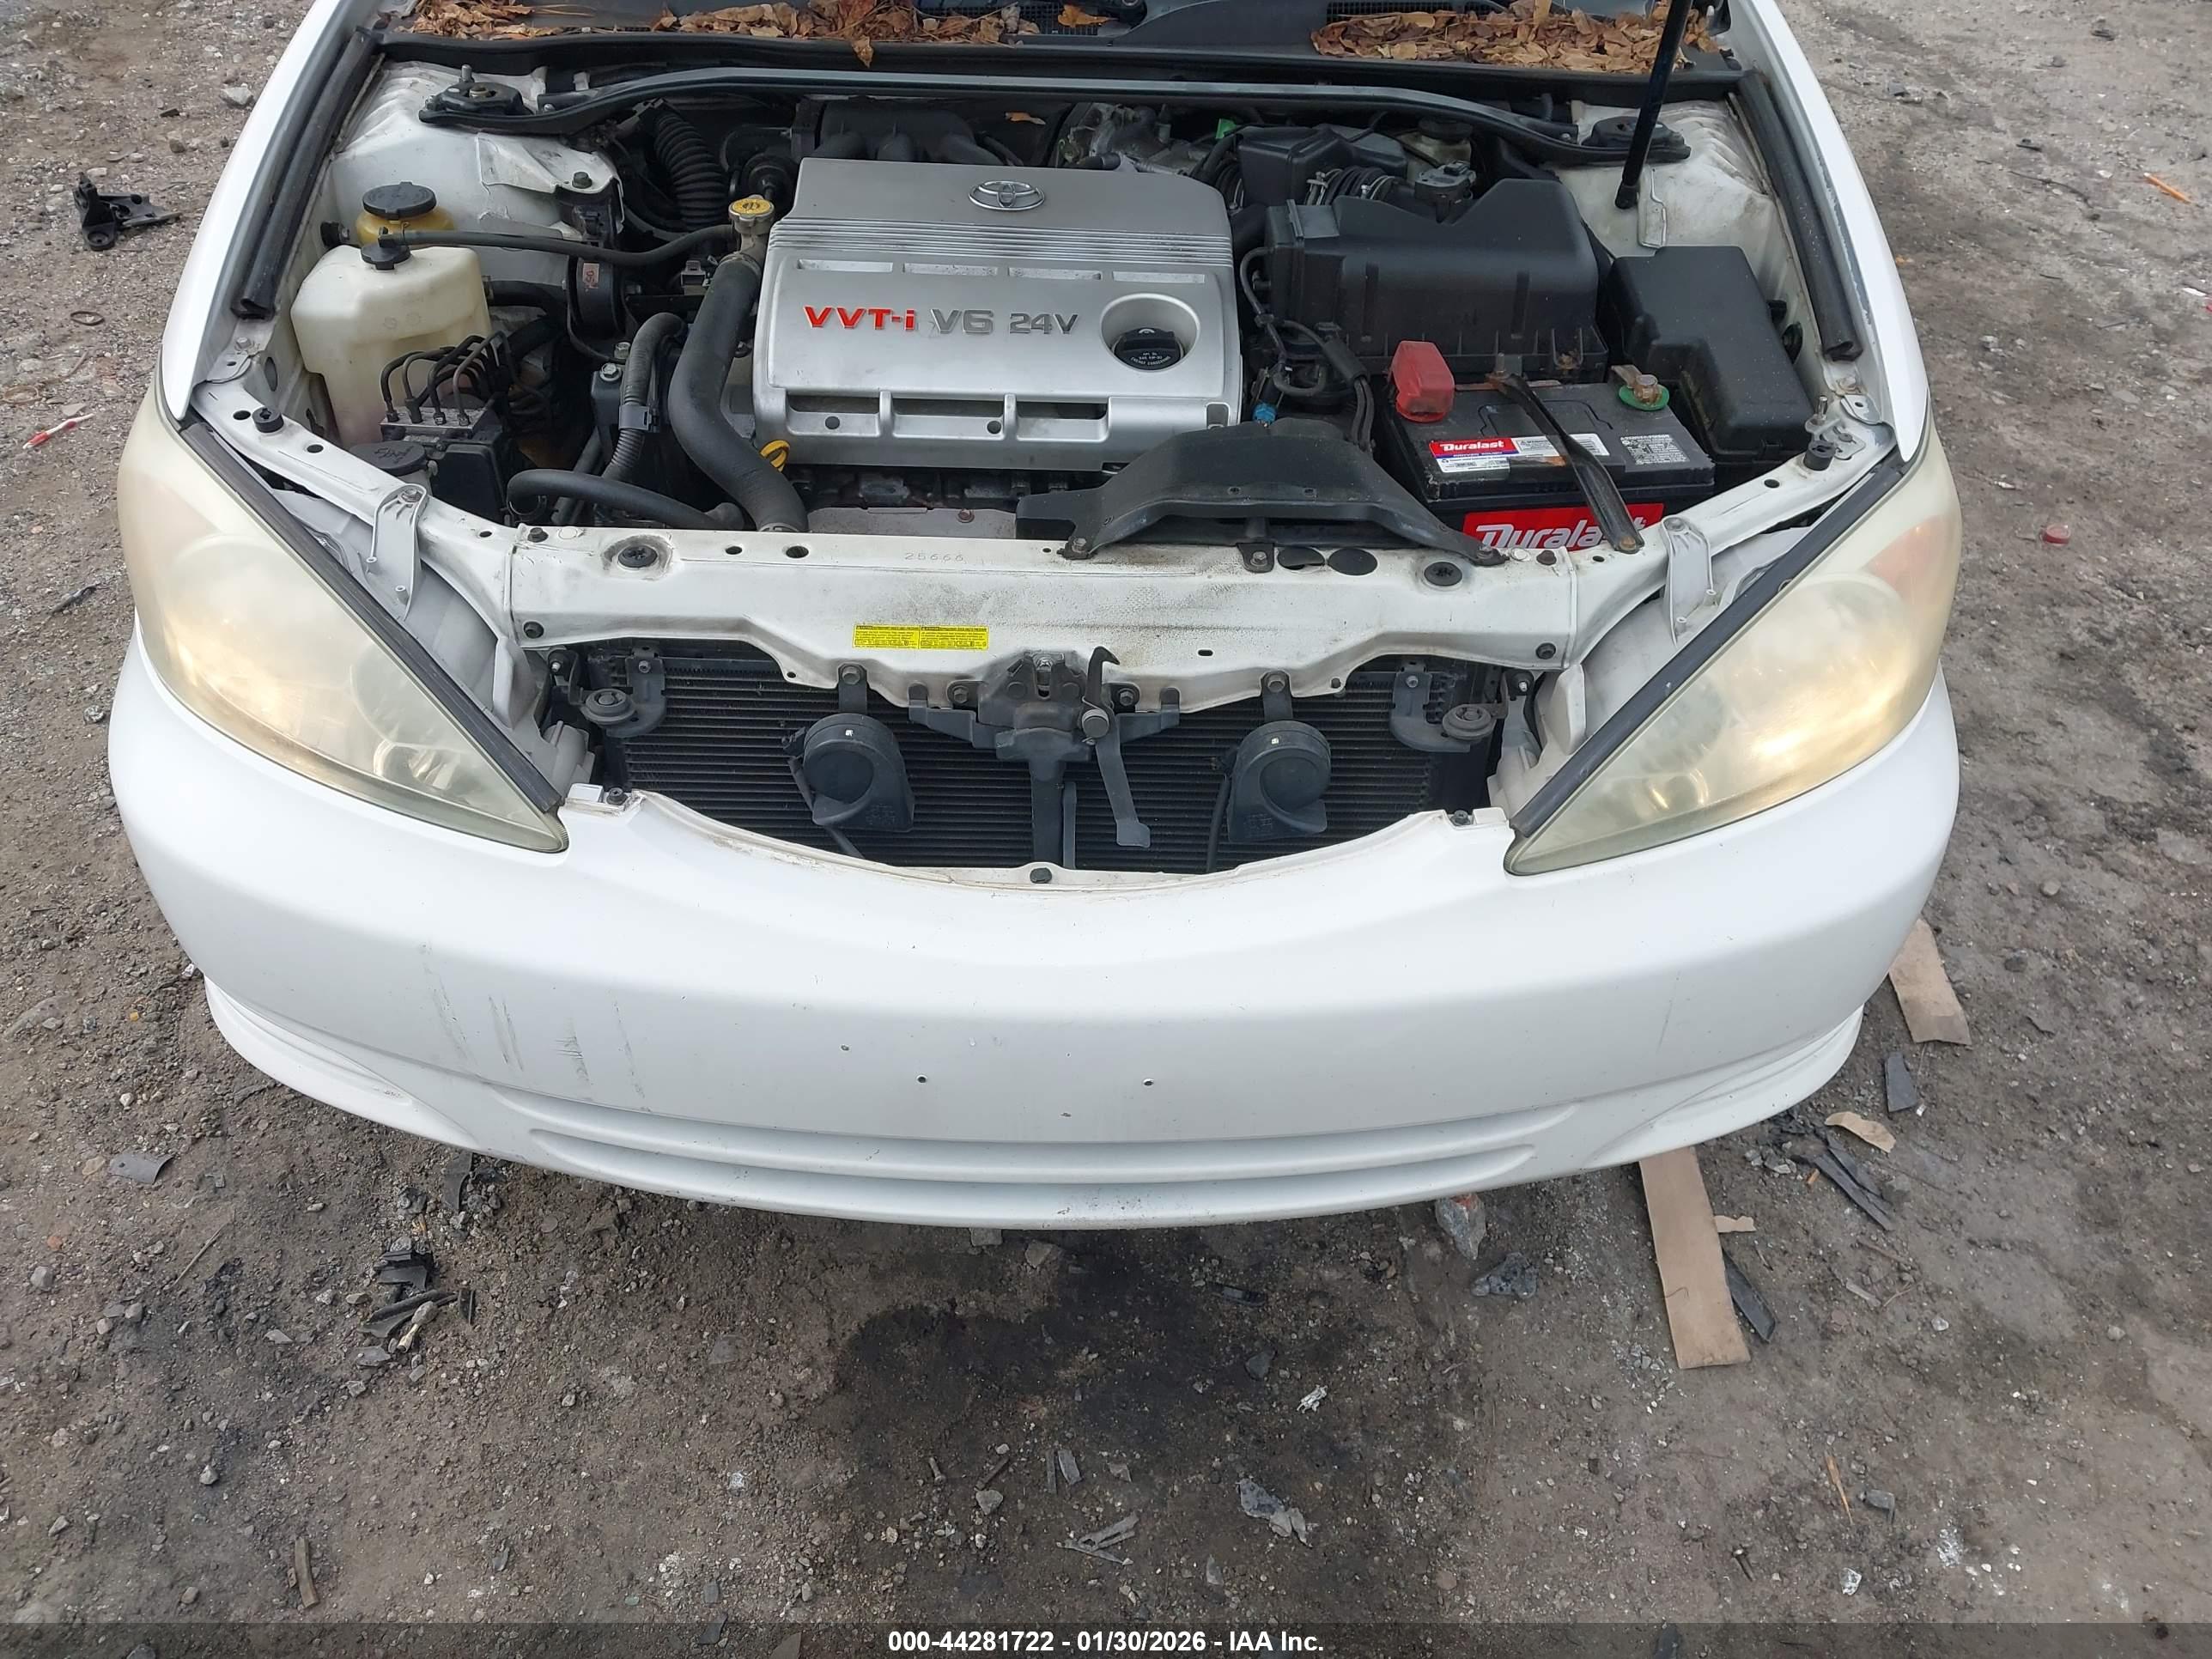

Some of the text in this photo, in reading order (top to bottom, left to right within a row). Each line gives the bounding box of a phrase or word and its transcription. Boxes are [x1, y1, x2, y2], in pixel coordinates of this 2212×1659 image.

[804, 307, 1079, 334] VVT-i V6 24V
[1440, 441, 1504, 452] Duralast
[1476, 517, 1647, 549] Duralat
